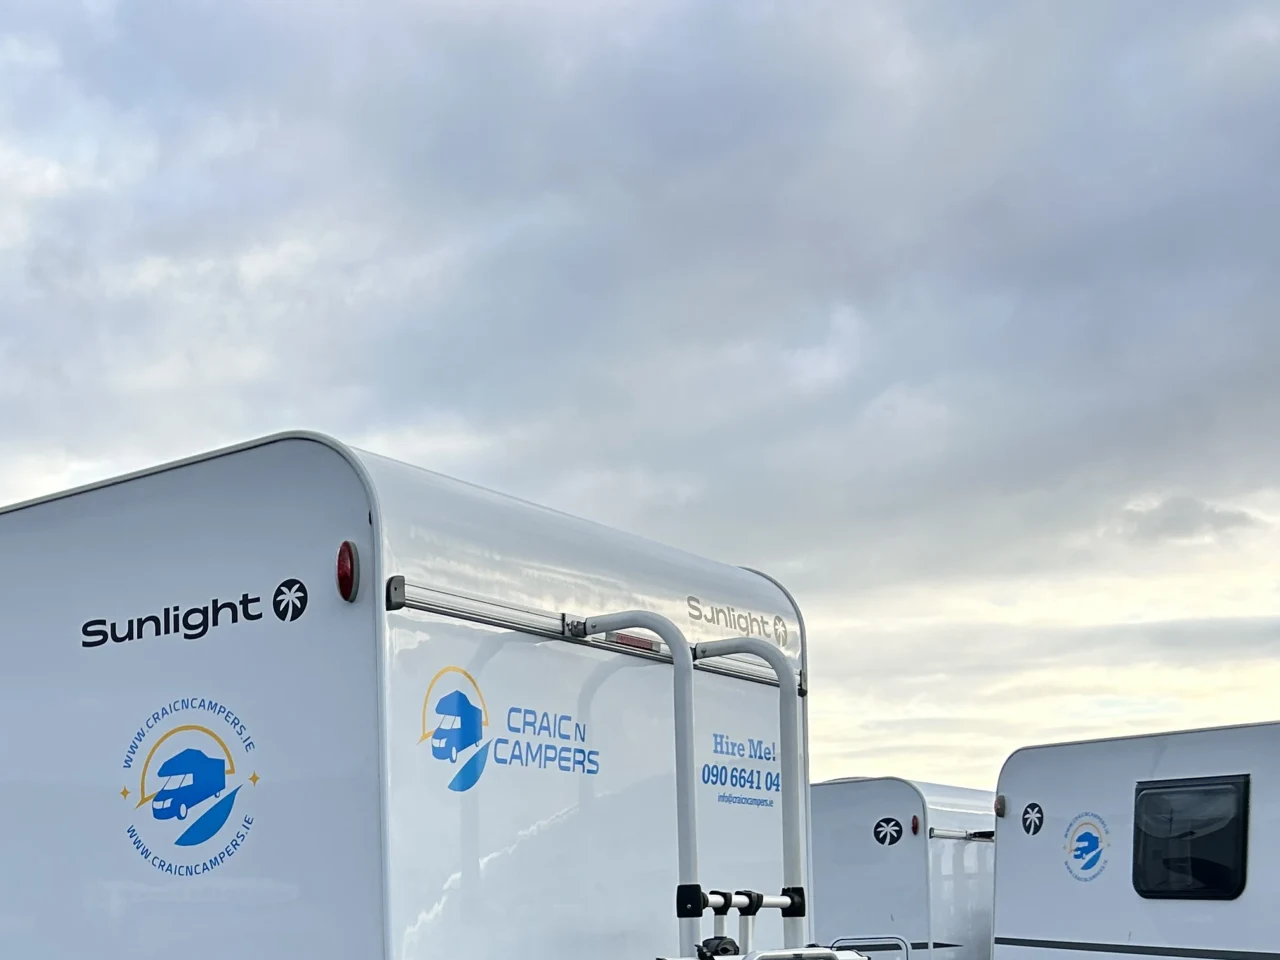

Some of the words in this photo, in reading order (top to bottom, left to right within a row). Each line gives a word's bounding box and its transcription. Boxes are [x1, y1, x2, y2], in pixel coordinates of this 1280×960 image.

[81, 593, 263, 648] Sunlight
[686, 595, 771, 638] Sunlight
[123, 698, 255, 769] WWW.CRAICNCAMPERS.IE
[507, 706, 572, 740] CRAIC
[574, 722, 586, 742] N
[493, 738, 600, 775] CAMPERS
[713, 733, 745, 757] Hire
[747, 738, 776, 761] Me!
[702, 763, 728, 786] 090
[730, 767, 762, 790] 6641
[765, 771, 781, 792] 04
[126, 814, 254, 876] WWW.CRAICNCAMPERS.IE
